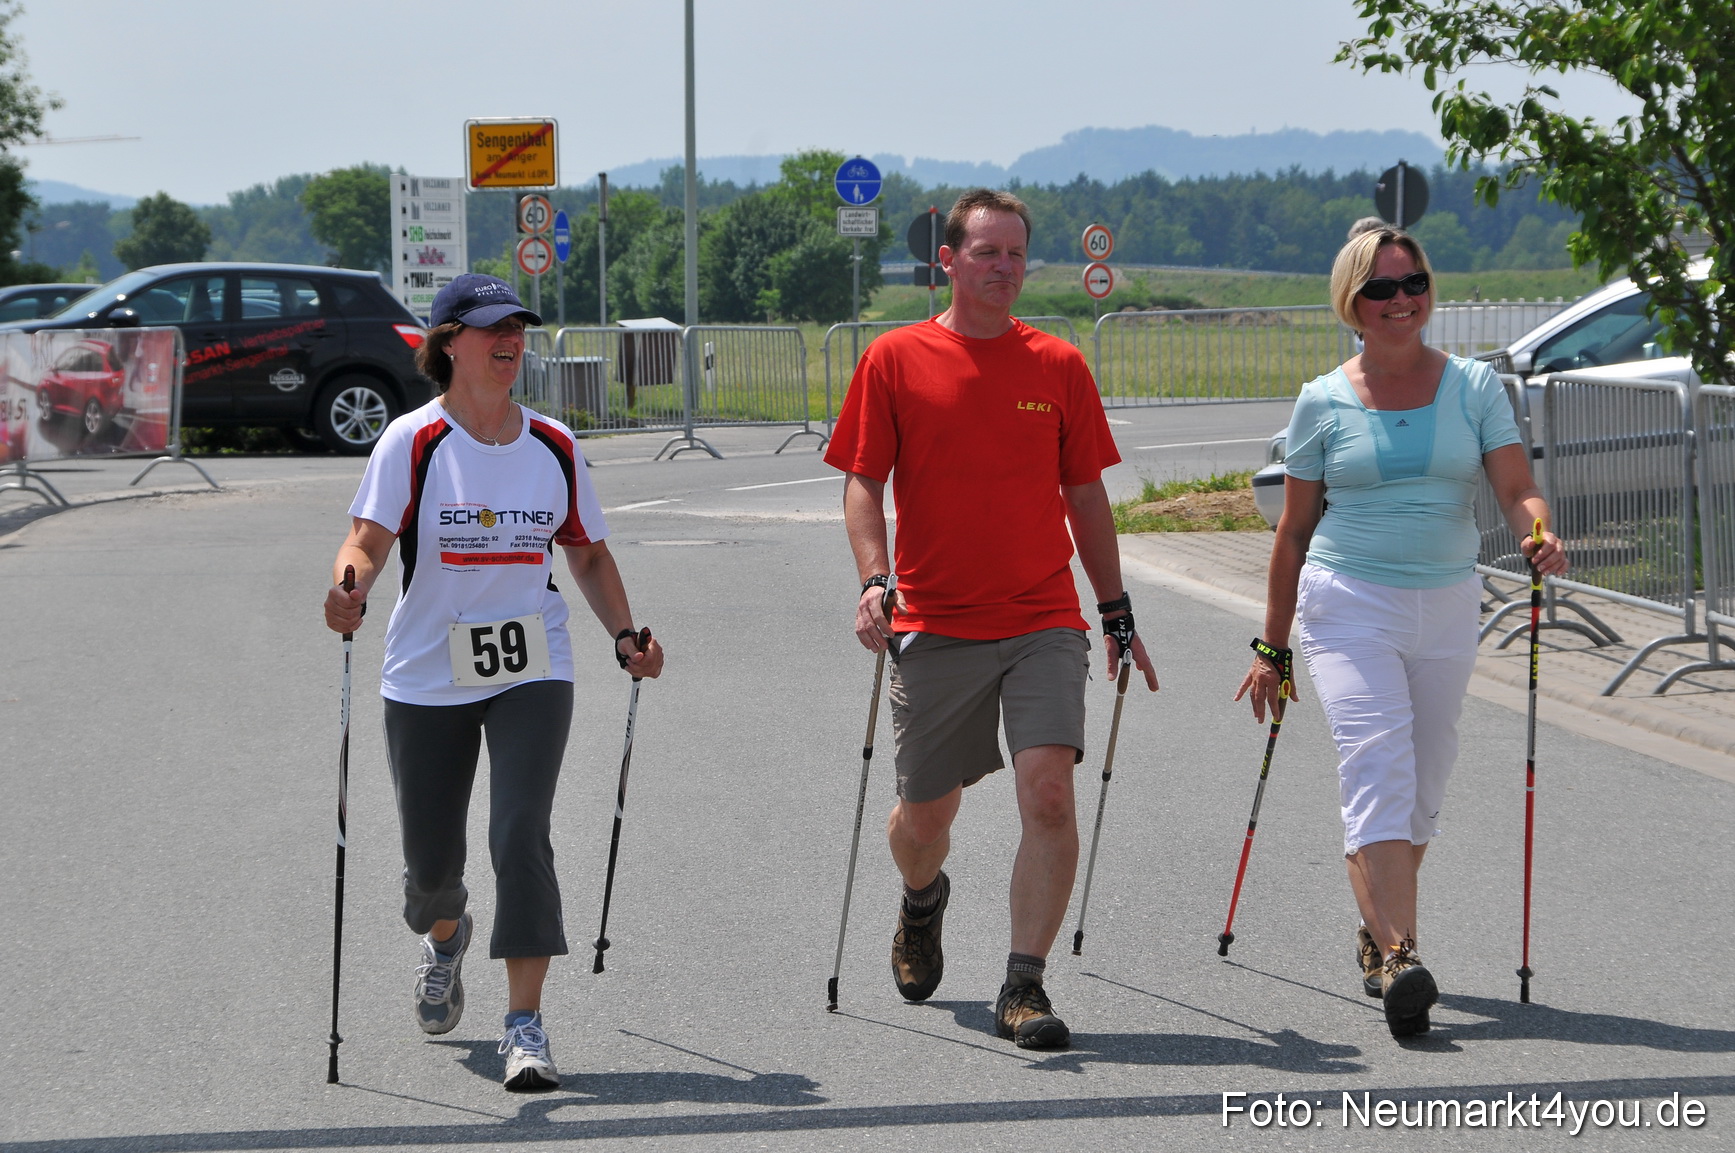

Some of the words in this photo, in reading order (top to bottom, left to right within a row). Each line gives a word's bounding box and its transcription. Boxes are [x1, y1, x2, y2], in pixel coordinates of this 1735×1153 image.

[476, 130, 547, 151] Sengenthal
[525, 206, 545, 224] 60
[1090, 234, 1107, 251] 60
[410, 272, 434, 288] THULE
[1017, 401, 1052, 413] LEKI
[470, 620, 529, 678] 59
